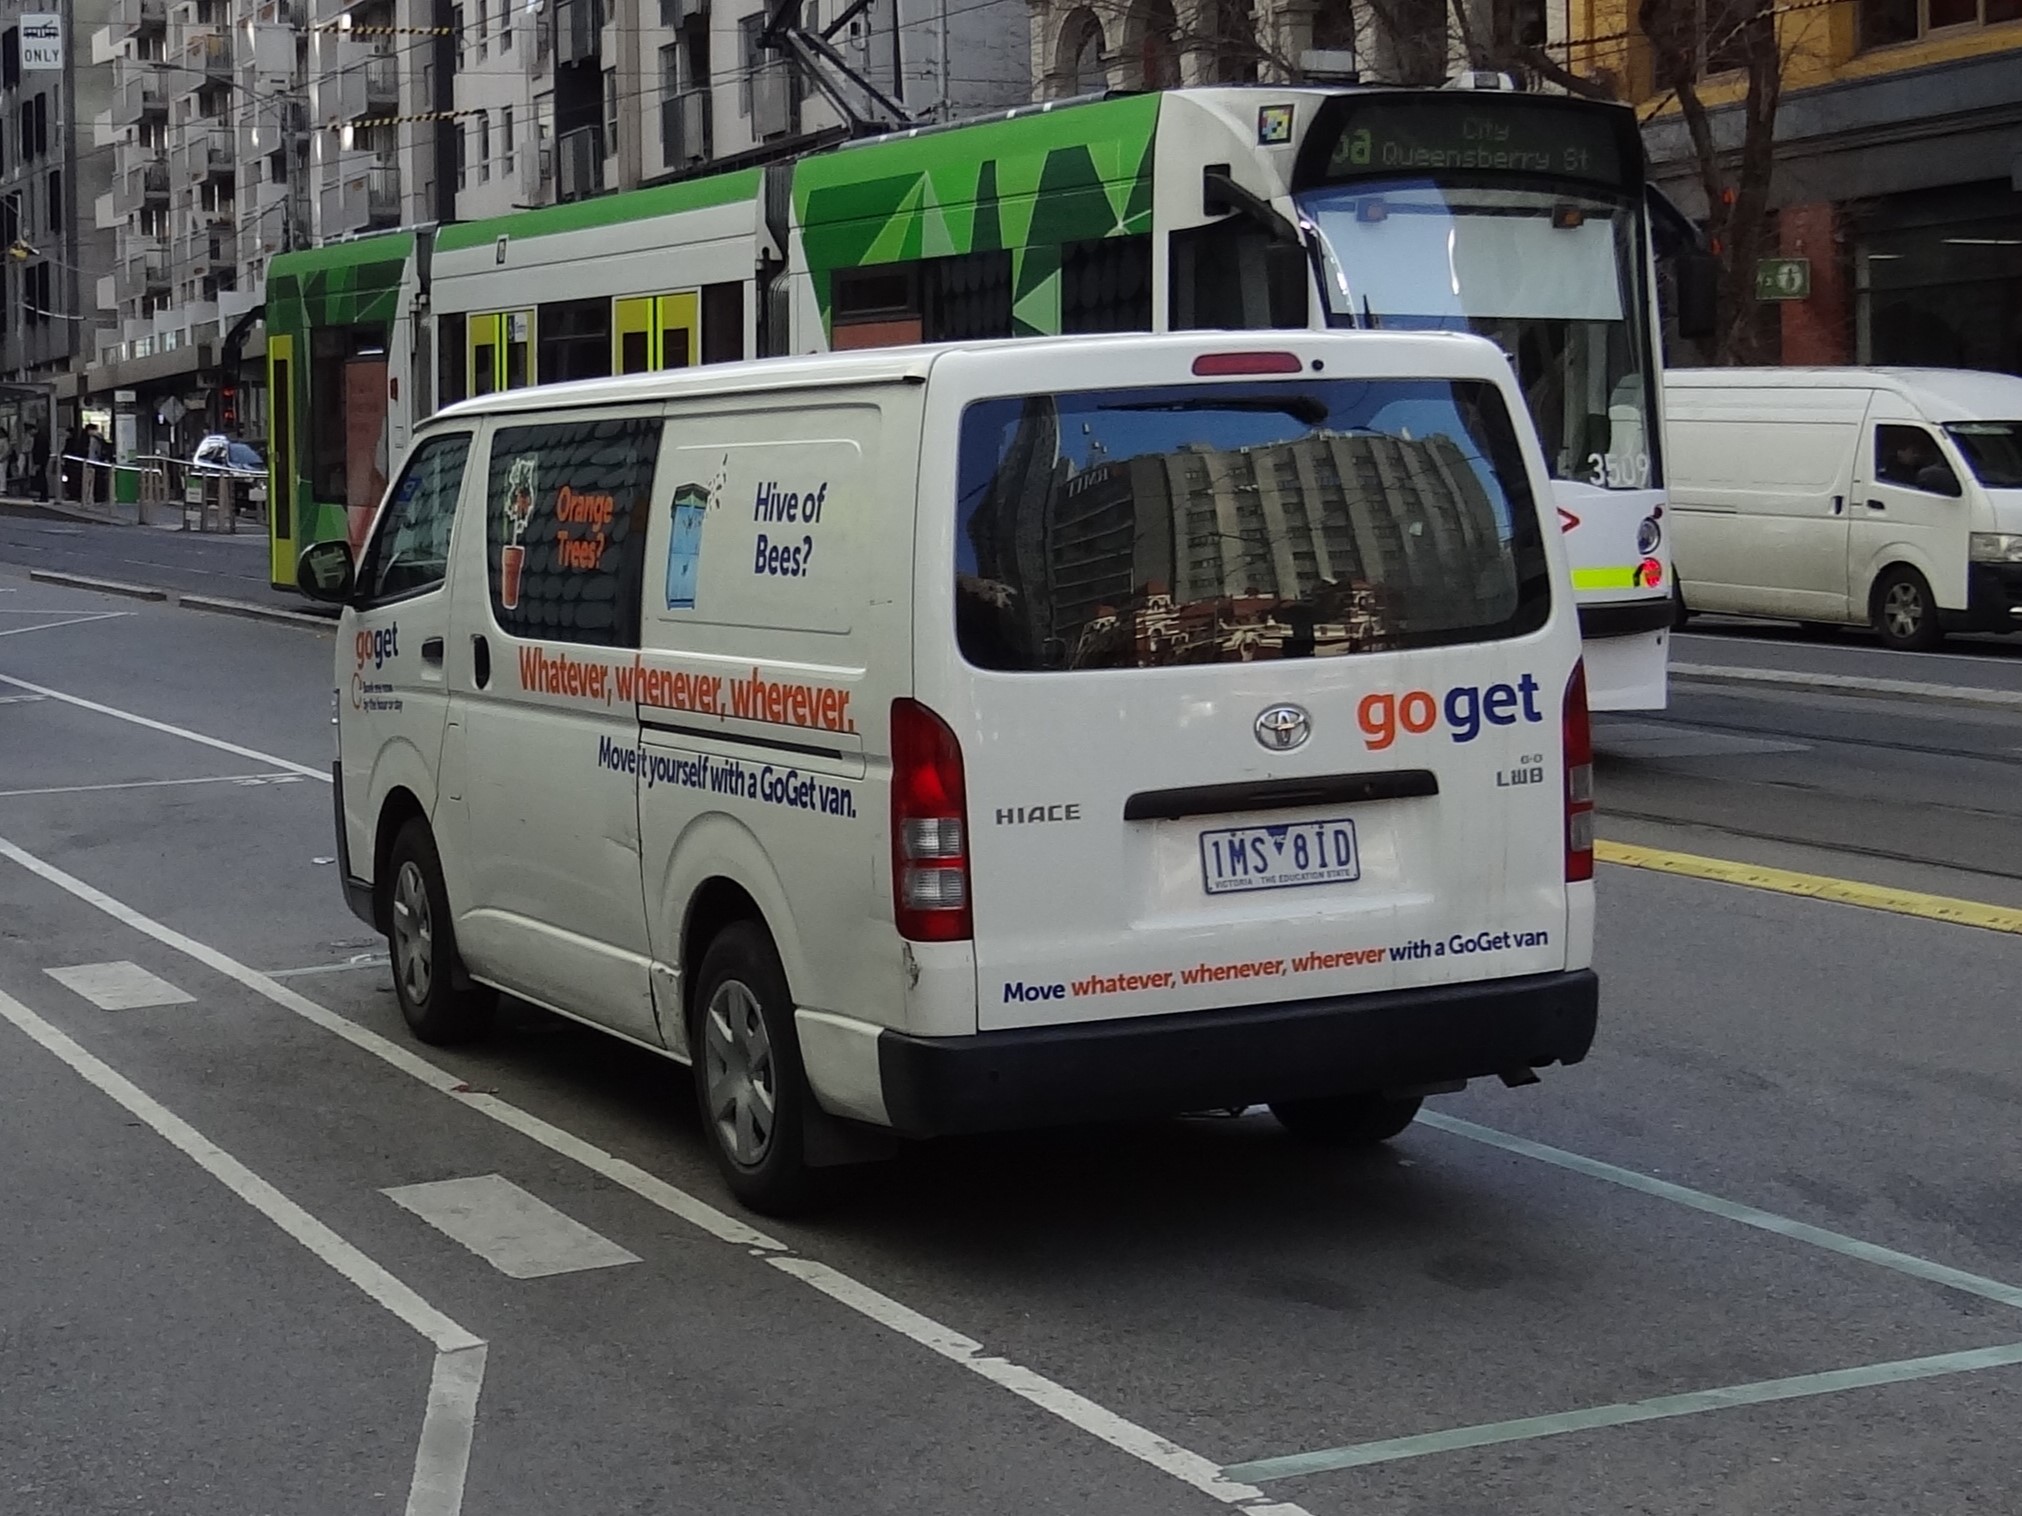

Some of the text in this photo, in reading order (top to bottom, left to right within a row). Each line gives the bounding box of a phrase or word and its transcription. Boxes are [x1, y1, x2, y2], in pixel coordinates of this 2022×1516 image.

[24, 49, 60, 62] ONLY
[1462, 118, 1510, 141] City
[1381, 141, 1588, 171] Queensberry St
[1587, 452, 1648, 489] 3509
[556, 485, 614, 533] Orange
[753, 481, 828, 523] Hive of
[557, 530, 605, 569] Trees?
[754, 534, 813, 577] Bees?
[355, 620, 399, 671] goget
[518, 645, 855, 733] Whatever, whenever, wherever.
[1357, 673, 1544, 751] goget
[598, 735, 857, 818] Move it yourself with a GoGet van.
[1496, 766, 1543, 787] LWB
[996, 803, 1081, 825] HIACE
[1211, 829, 1351, 878] 1MS 8ID
[1214, 868, 1350, 889] VICTORIA THE EDUCATION STATE
[1003, 931, 1549, 1003] Move whatever, whenever, wherever with a GoGet van
